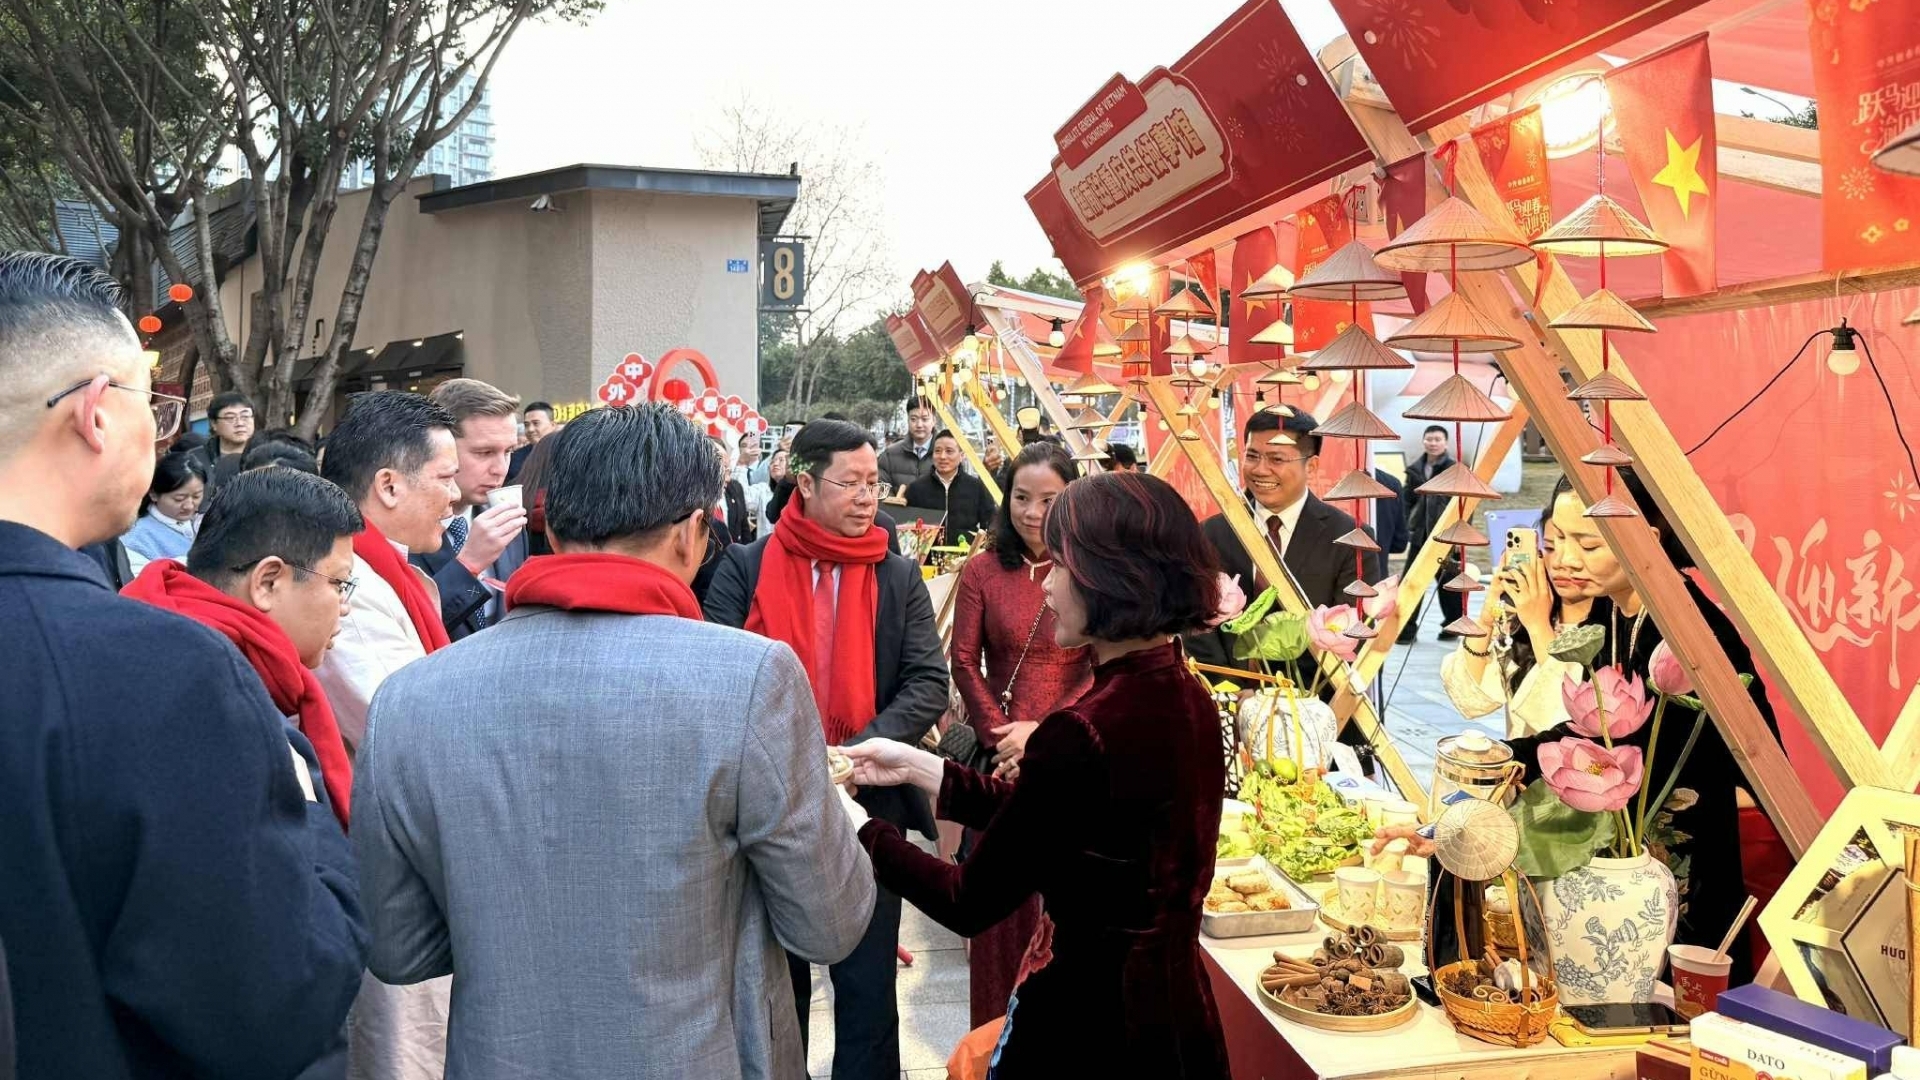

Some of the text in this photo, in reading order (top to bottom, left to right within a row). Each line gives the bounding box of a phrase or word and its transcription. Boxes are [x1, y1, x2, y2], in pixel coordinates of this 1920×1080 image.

[1078, 110, 1099, 133] GENERAL
[1095, 103, 1104, 117] OF
[1101, 83, 1128, 111] VIETNAM
[773, 247, 795, 300] 8
[1747, 1048, 1785, 1070] DATO
